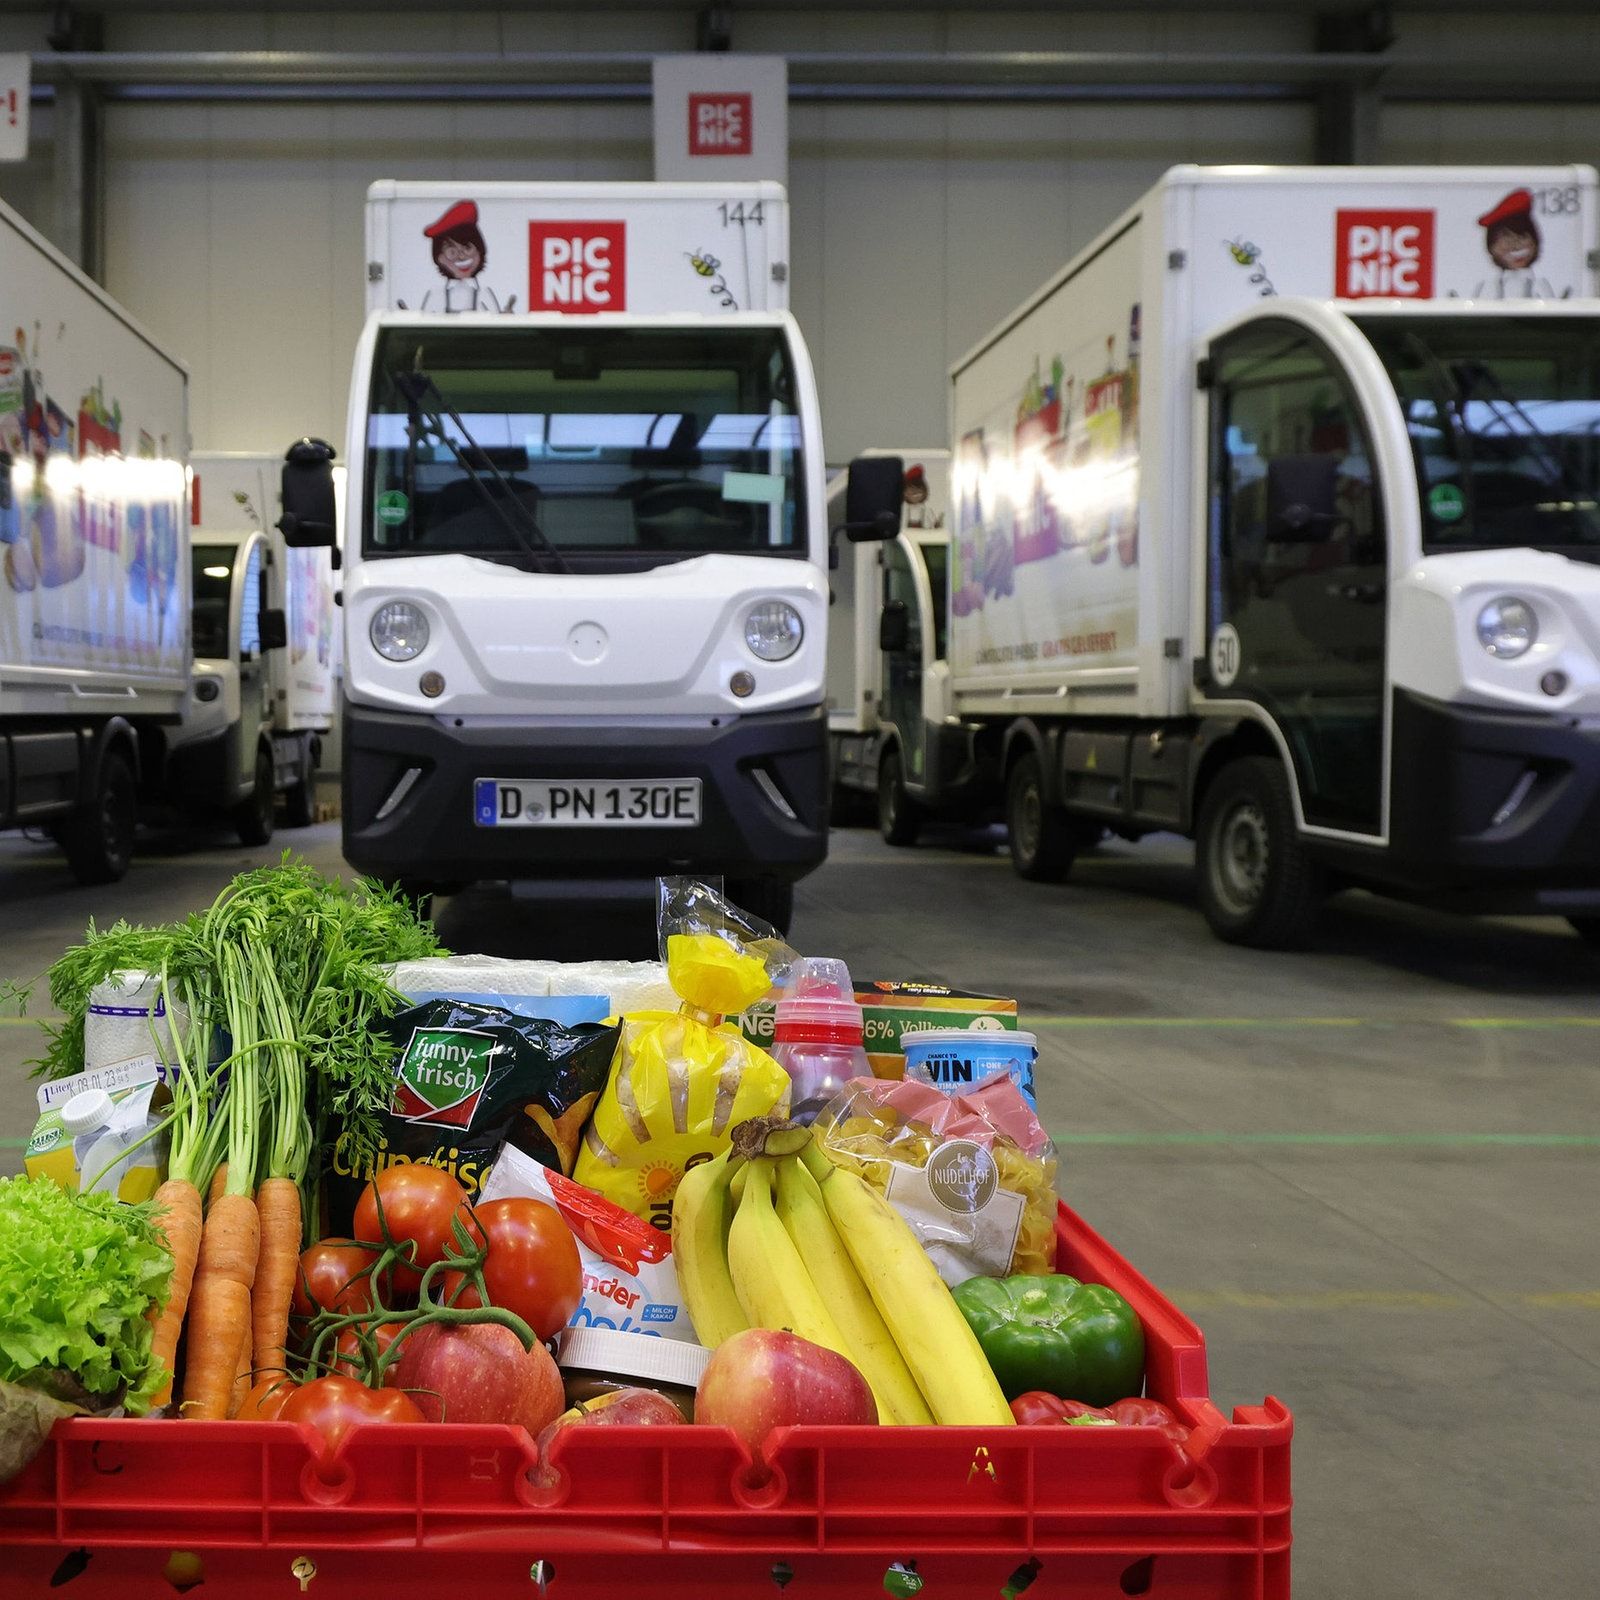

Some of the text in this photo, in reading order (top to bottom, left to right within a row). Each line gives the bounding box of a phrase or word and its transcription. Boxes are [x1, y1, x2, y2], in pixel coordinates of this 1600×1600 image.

[698, 103, 742, 123] PIC
[717, 201, 765, 228] 144
[1536, 187, 1581, 214] 138
[543, 237, 612, 270] PIC
[1348, 225, 1421, 259] PIC
[1218, 637, 1236, 675] 50
[500, 786, 695, 819] D PN 130E
[857, 1019, 895, 1040] 6%
[414, 1037, 478, 1067] funny-
[416, 1058, 477, 1091] frisch
[934, 1168, 990, 1185] NUDELHOF
[582, 1268, 641, 1310] nder
